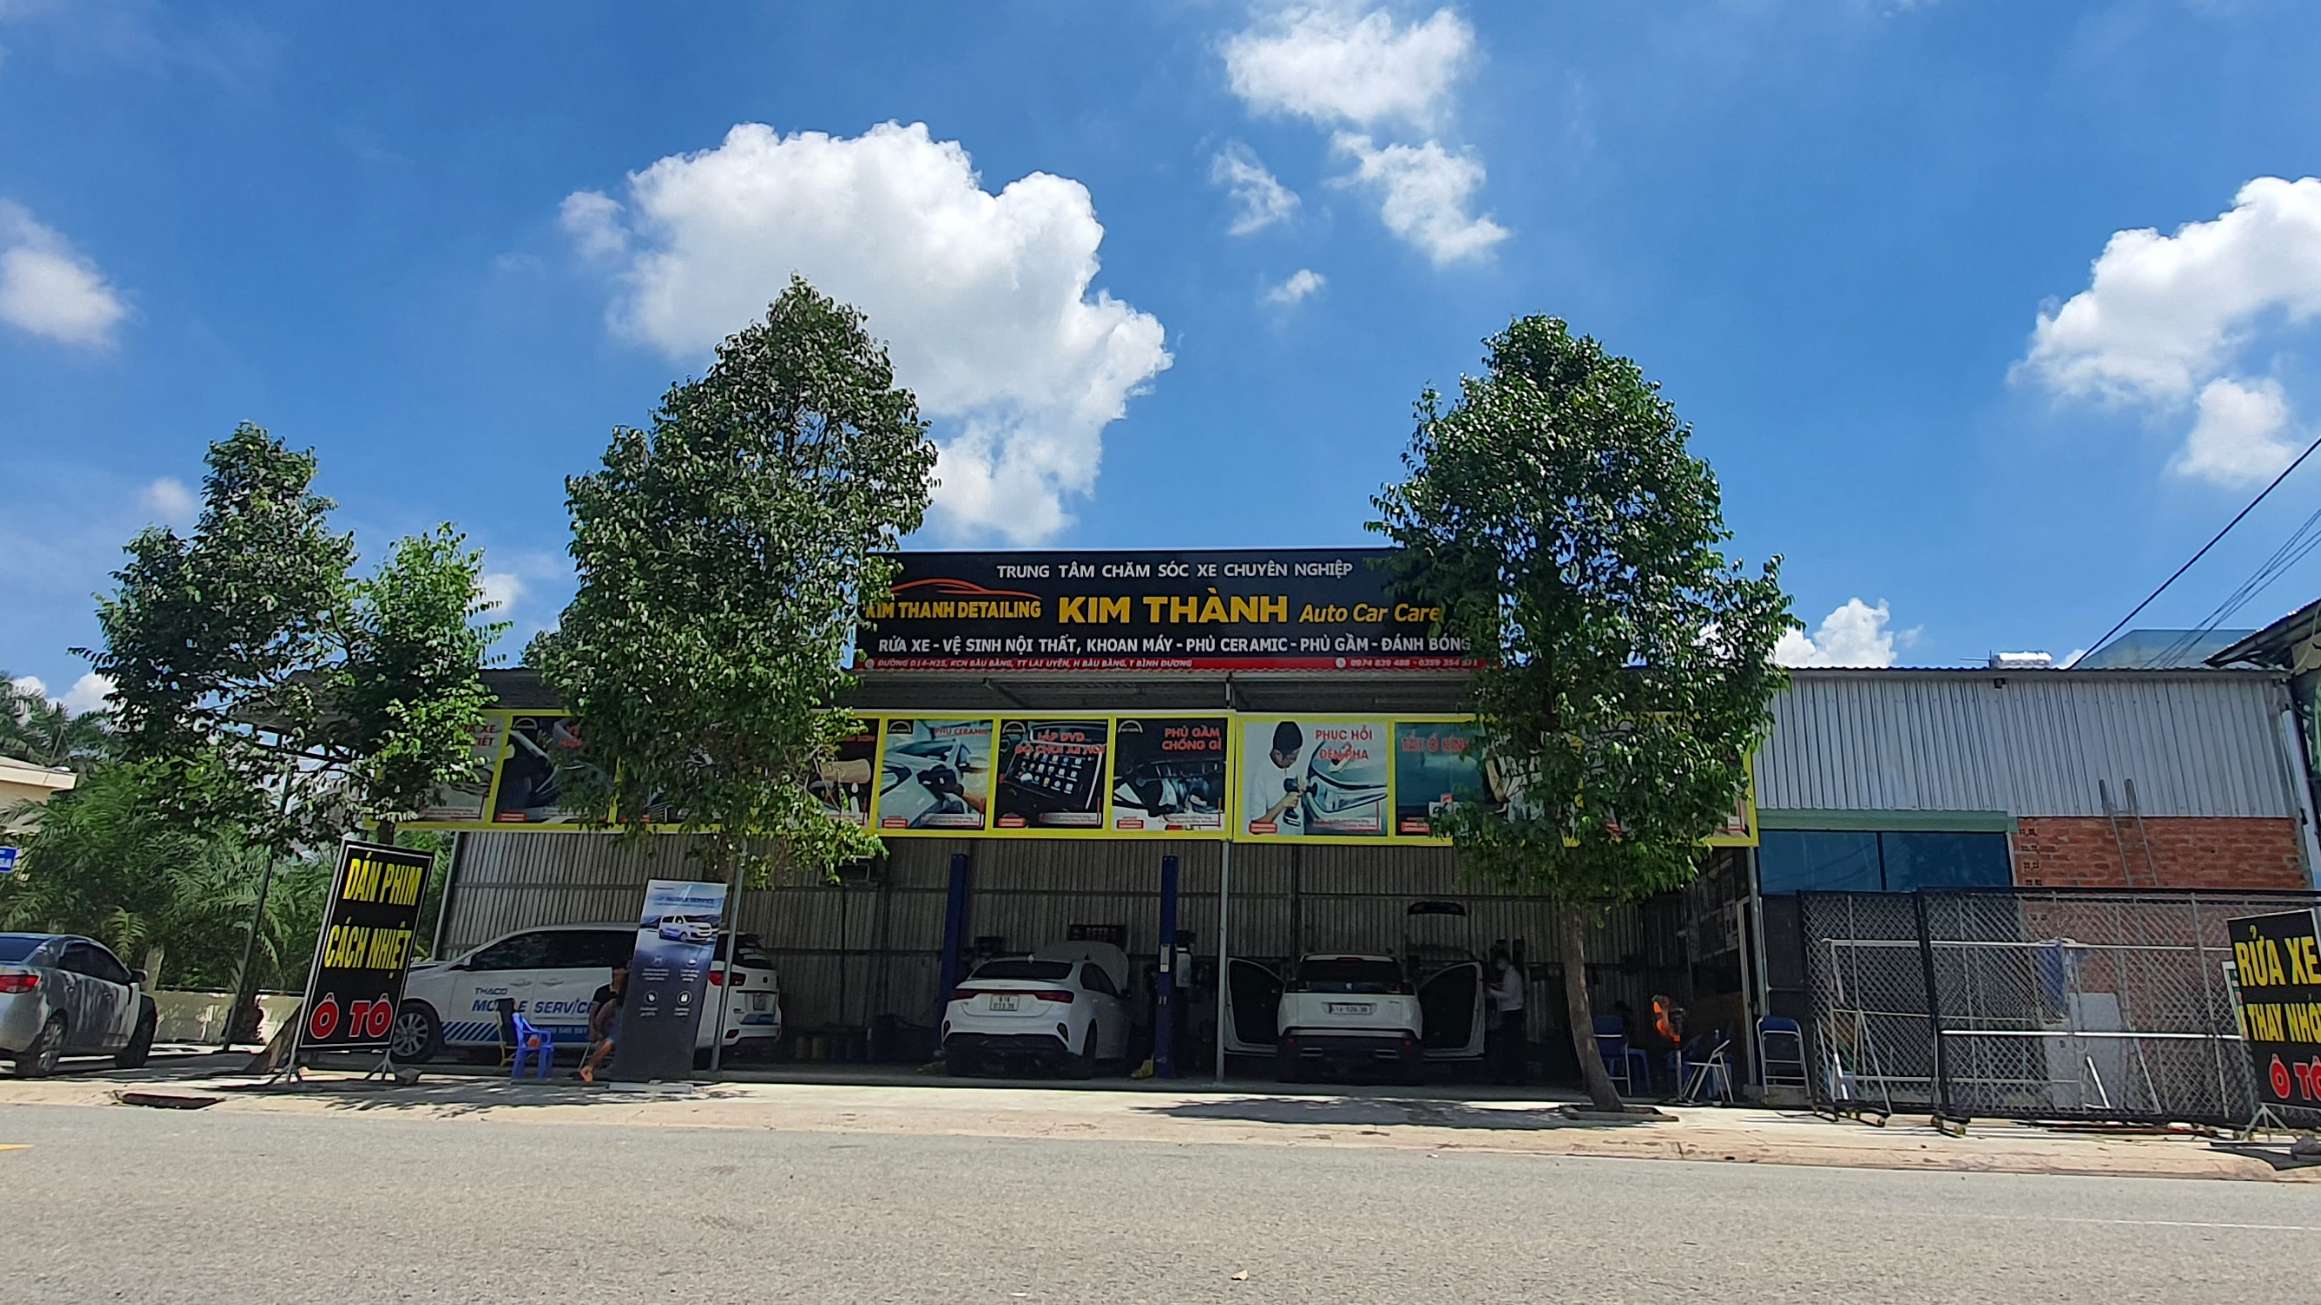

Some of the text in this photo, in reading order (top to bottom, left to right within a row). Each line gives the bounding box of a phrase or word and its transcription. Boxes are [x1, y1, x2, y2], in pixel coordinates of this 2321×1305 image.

[997, 559, 1353, 580] TRUNG TÂM CHĂM SÓC XE CHUYÊN NGHIỆP
[898, 601, 955, 618] THANH
[957, 600, 1041, 618] DETAILING
[1058, 587, 1441, 623] KIM THÀNH Auto Car Care
[879, 635, 907, 652] RỬA
[911, 638, 930, 652] XE
[943, 635, 961, 655] VỆ
[966, 638, 1002, 652] SINH
[1005, 635, 1033, 655] NỘI
[1038, 634, 1082, 654] THẤT,
[1087, 638, 1138, 652] KHOAN
[1142, 634, 1173, 652] MÁY
[1186, 634, 1216, 652] PHỦ
[1220, 638, 1288, 652] CERAMIC
[1300, 634, 1331, 651] PHỦ
[1335, 633, 1369, 651] GẦM
[1381, 633, 1424, 651] ĐÁNH
[1429, 633, 1471, 651] BÓNG
[1059, 731, 1086, 742] DVD
[1164, 724, 1221, 738] PHỦ GẦM
[1161, 738, 1206, 751] CHỐNG
[342, 851, 423, 907] DÁN PHIM
[323, 915, 413, 979] CÁCH NHIỆT
[2234, 925, 2321, 987] RỬA XE
[474, 987, 509, 996] THACO
[309, 991, 394, 1040] Ô TÔ
[533, 997, 592, 1015] SERVIC
[2246, 1003, 2285, 1042] THAY
[2269, 1052, 2291, 1100] Ô
